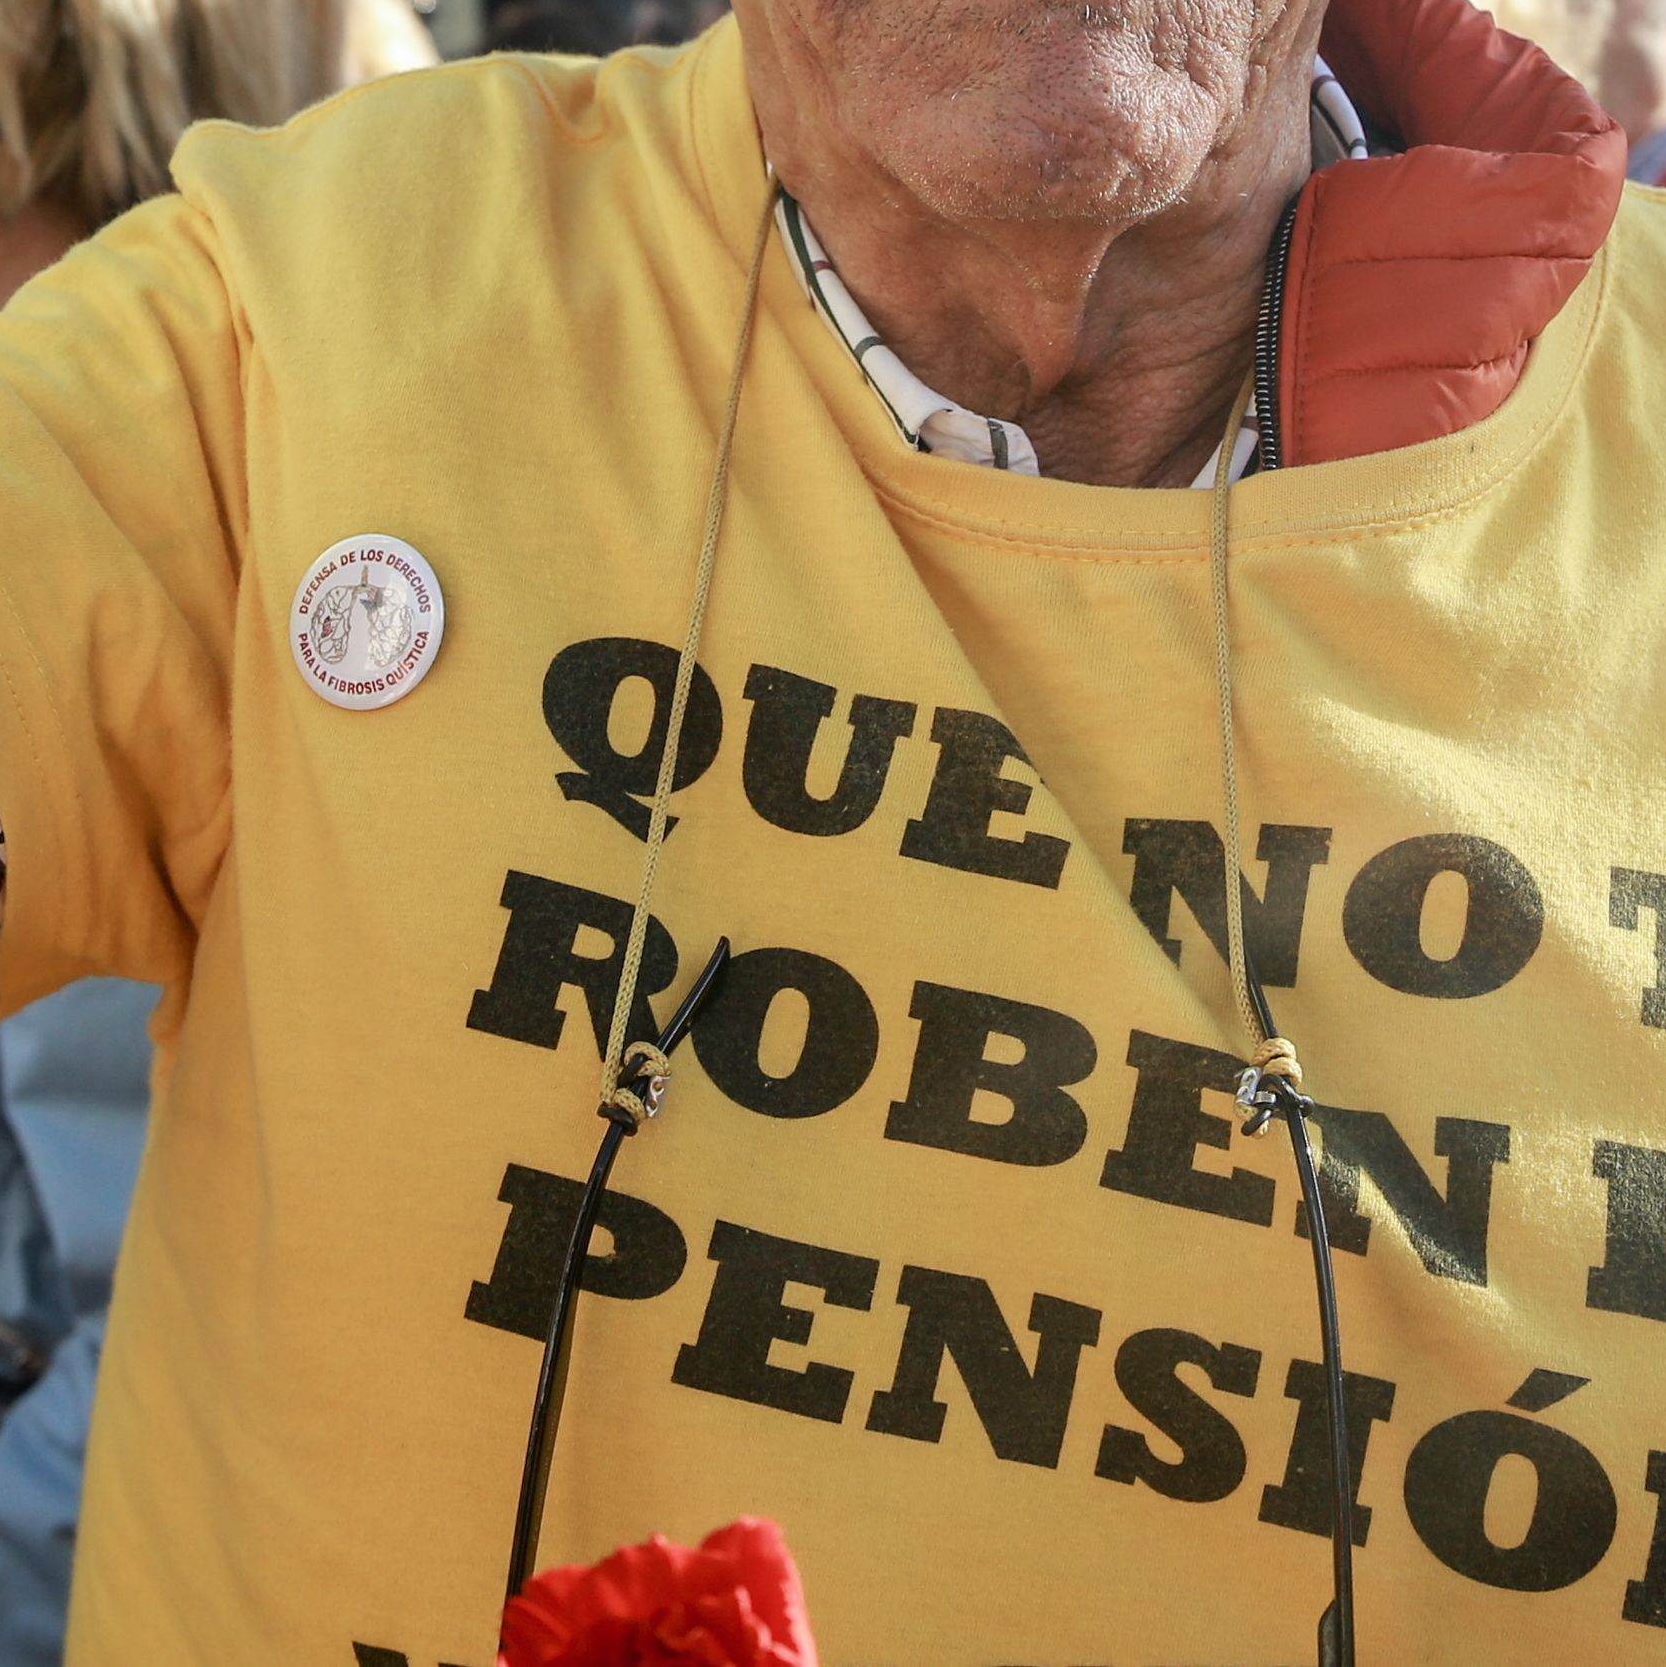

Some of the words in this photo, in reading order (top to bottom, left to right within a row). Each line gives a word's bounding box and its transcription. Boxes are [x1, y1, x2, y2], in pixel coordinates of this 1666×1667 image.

[299, 561, 337, 615] DEFENSA
[340, 551, 356, 566] DE
[360, 549, 384, 563] LOS
[386, 554, 431, 614] DERECHOS
[299, 632, 315, 669] PARA
[313, 664, 328, 683] LA
[327, 675, 386, 695] FIBROSIS
[386, 631, 430, 686] QUÍSTICA
[542, 636, 1071, 890] QUE
[1122, 818, 1544, 999] NO
[466, 869, 1511, 1288] ROBEN
